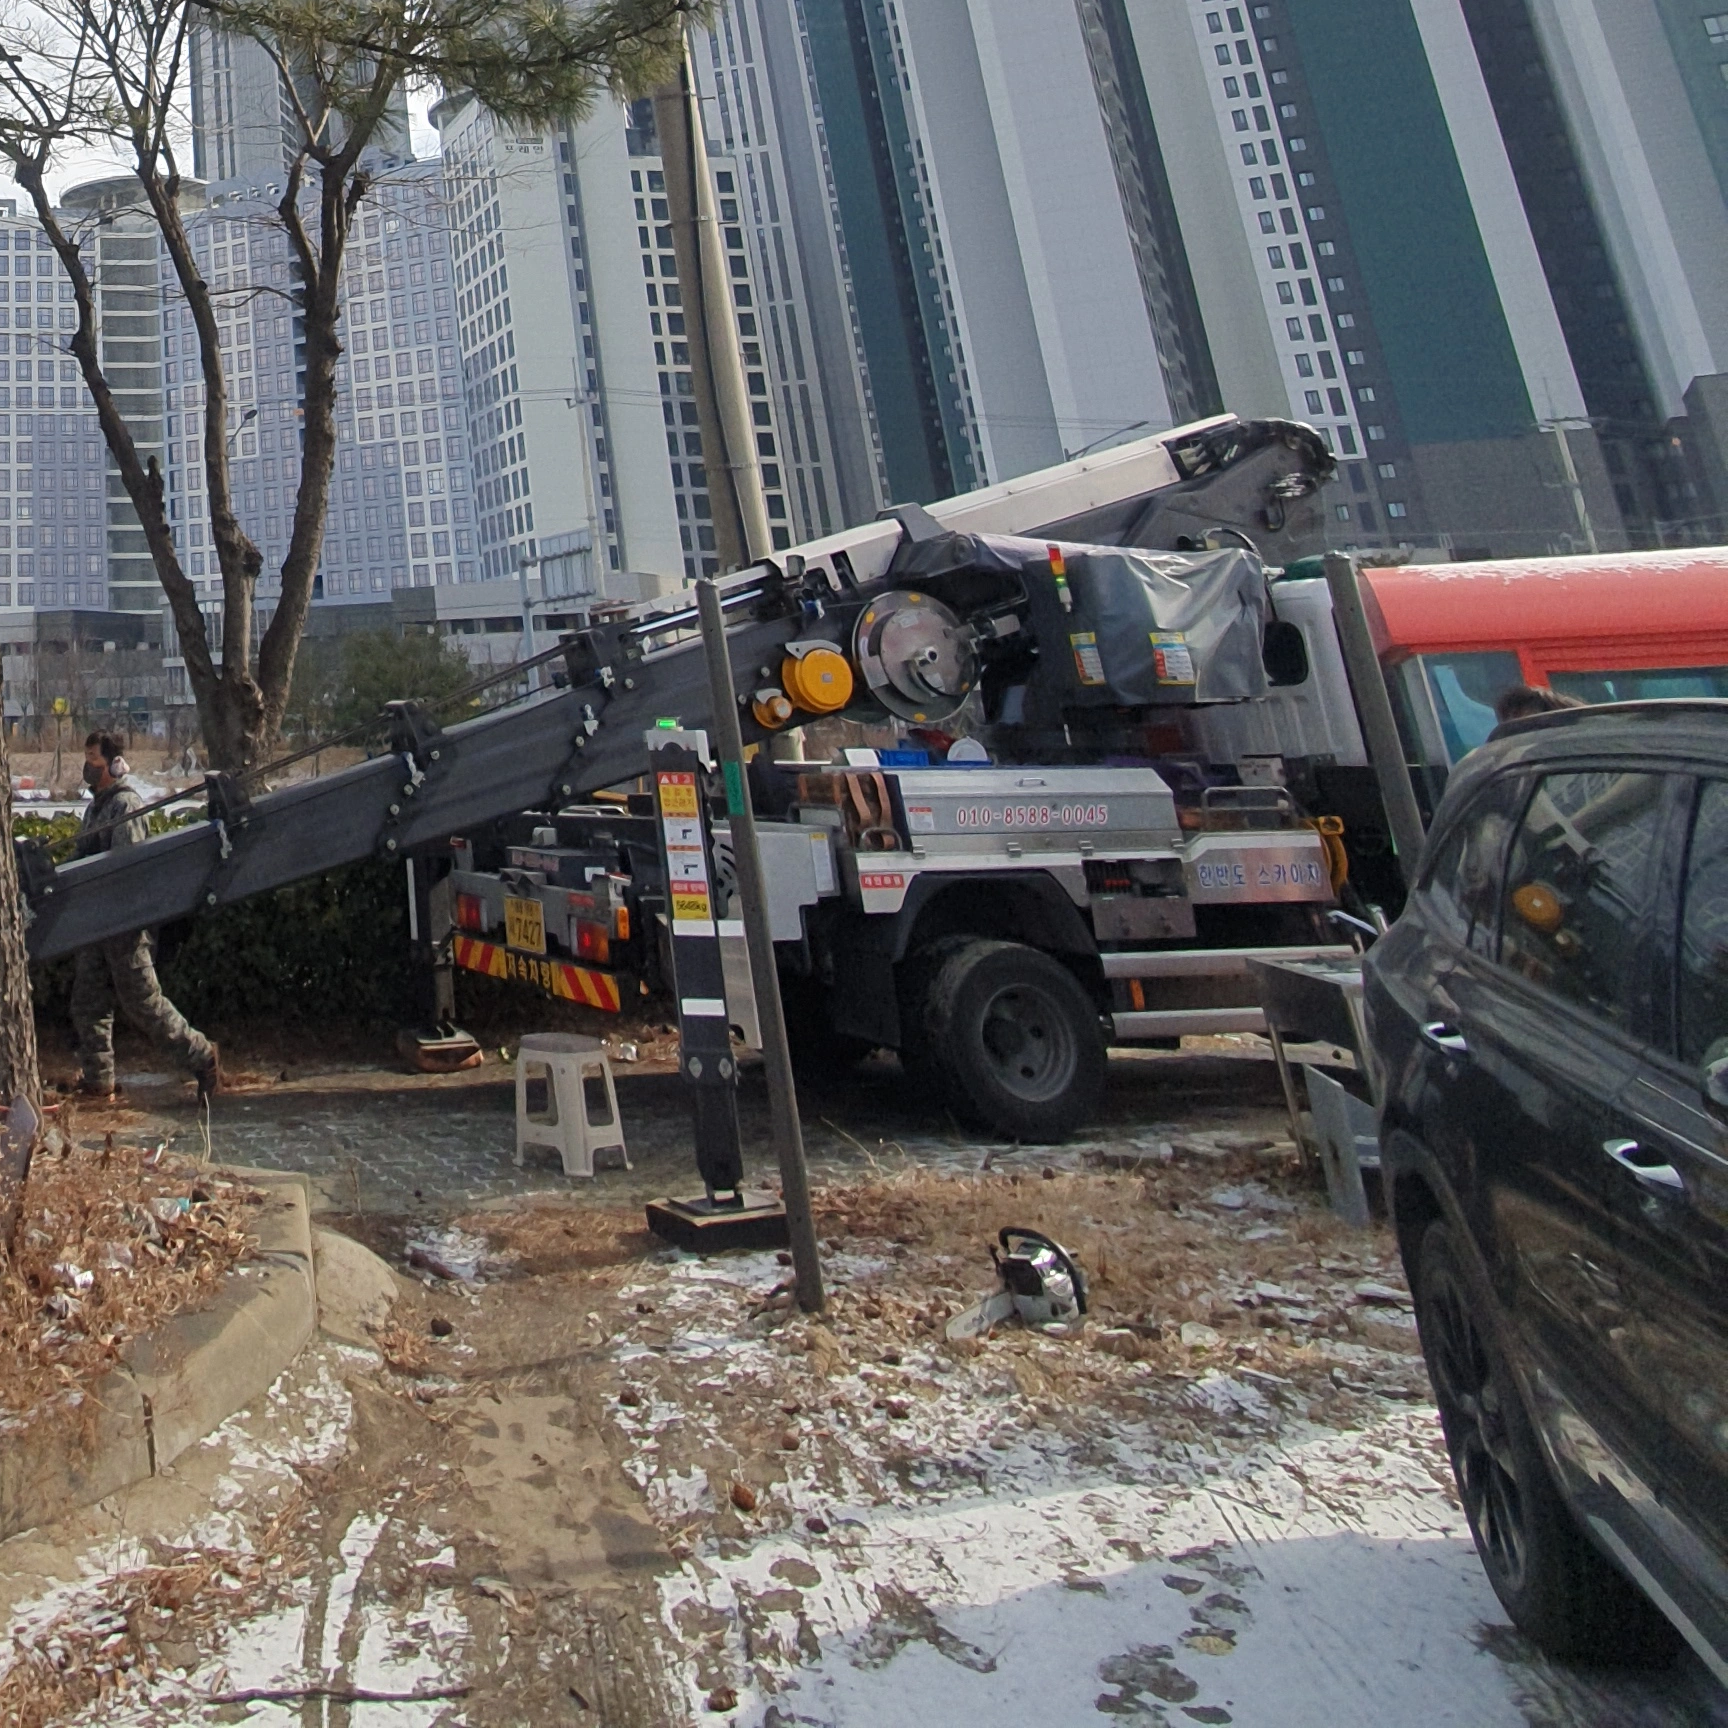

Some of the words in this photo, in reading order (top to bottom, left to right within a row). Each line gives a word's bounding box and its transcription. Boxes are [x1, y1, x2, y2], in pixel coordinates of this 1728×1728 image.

[957, 804, 1108, 827] 010-8588-0045
[1198, 864, 1246, 888] 한반도
[1257, 862, 1320, 886] 스카이차
